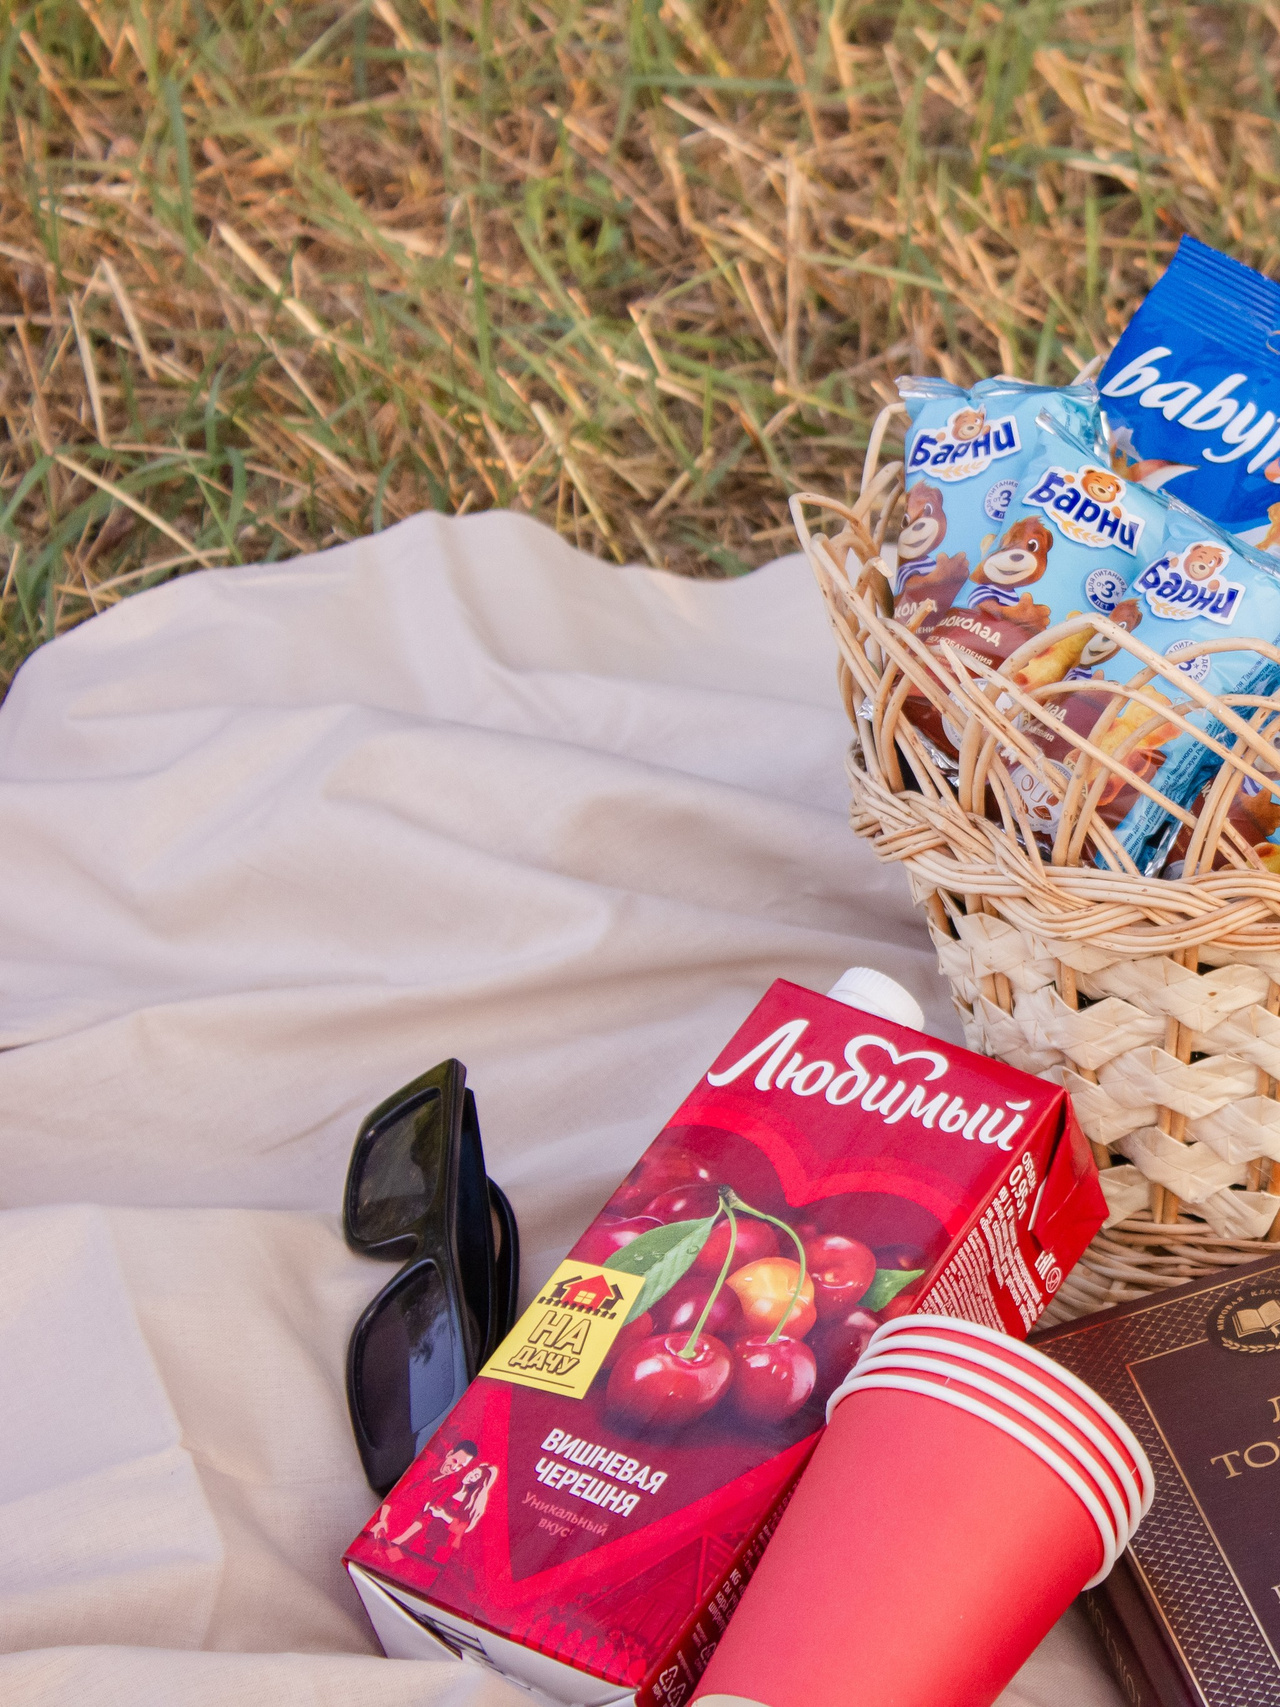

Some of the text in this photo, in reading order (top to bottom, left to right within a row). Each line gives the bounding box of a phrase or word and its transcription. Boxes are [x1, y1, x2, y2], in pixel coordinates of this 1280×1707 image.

[909, 421, 1016, 467] Барни
[1028, 472, 1139, 550] Барни
[1139, 557, 1240, 618] Барни
[706, 1018, 1031, 1151] Любимый
[528, 1310, 592, 1355] НА
[1217, 1297, 1244, 1331] МИРОВАЯ
[508, 1345, 580, 1375] ДАЧУ
[534, 1457, 641, 1518] ЧЕРЕШНЯ
[540, 1428, 668, 1495] ВИШНЕВАЯ
[522, 1491, 609, 1537] Уникальный
